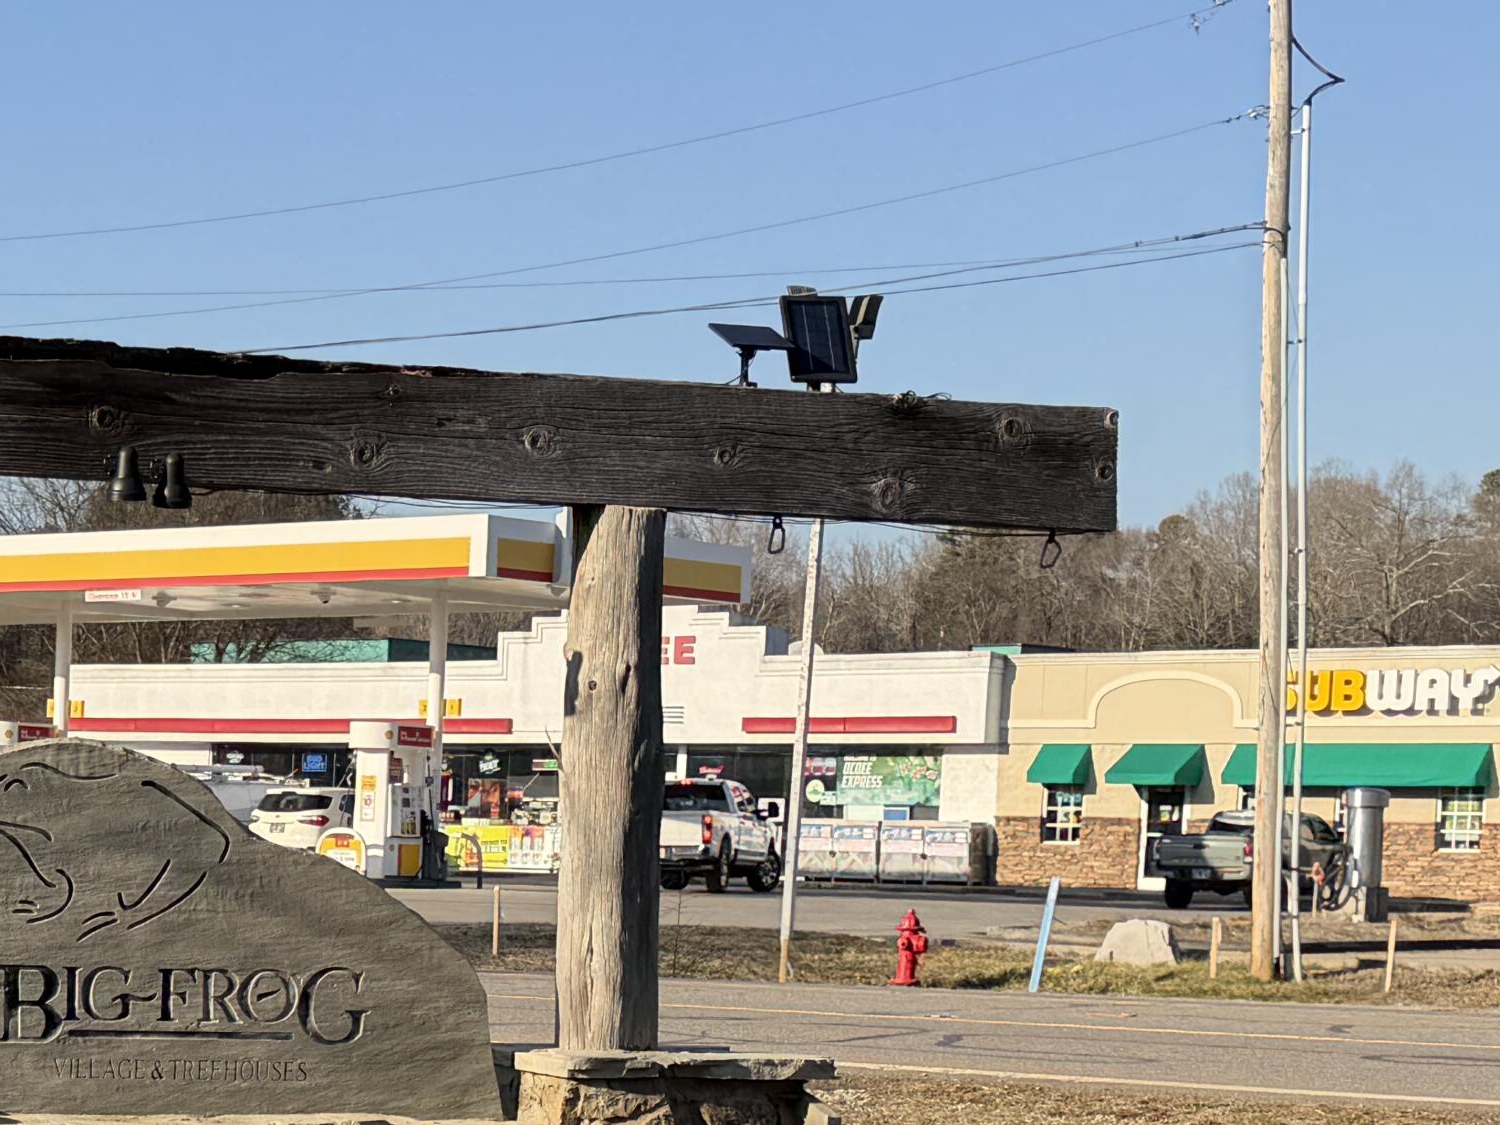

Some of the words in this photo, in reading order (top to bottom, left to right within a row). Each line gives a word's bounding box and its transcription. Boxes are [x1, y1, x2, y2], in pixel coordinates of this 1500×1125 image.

[842, 775, 883, 788] EXPRESS
[156, 966, 371, 1046] FROG
[53, 1057, 145, 1081] VILLAGE
[151, 1062, 165, 1081] &
[168, 1058, 308, 1083] TREEHOUSES
